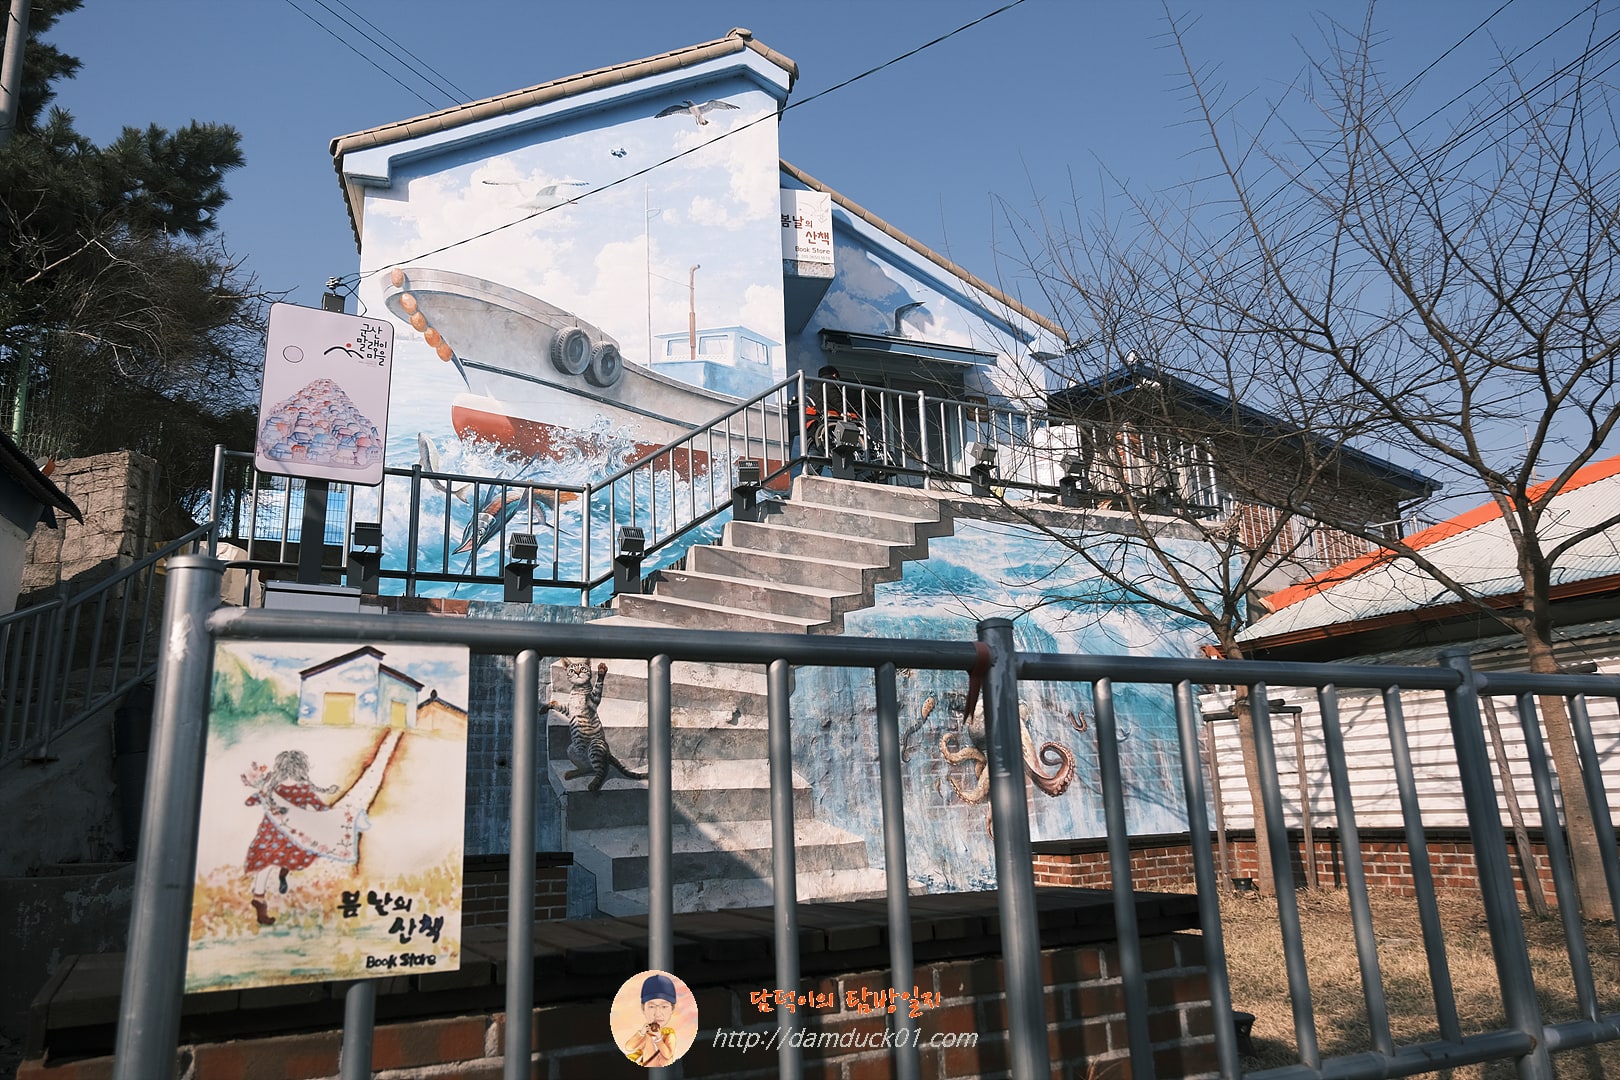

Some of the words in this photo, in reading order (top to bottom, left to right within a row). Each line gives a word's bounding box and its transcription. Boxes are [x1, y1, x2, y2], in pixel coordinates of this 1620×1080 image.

[780, 213, 813, 229] 봄날의
[805, 231, 830, 245] 산책
[811, 246, 830, 254] Store
[360, 323, 383, 340] 군산
[356, 337, 388, 353] 말랭이
[366, 350, 386, 367] 마을
[388, 913, 444, 944] 산책
[365, 954, 398, 969] Book
[399, 953, 437, 967] Store
